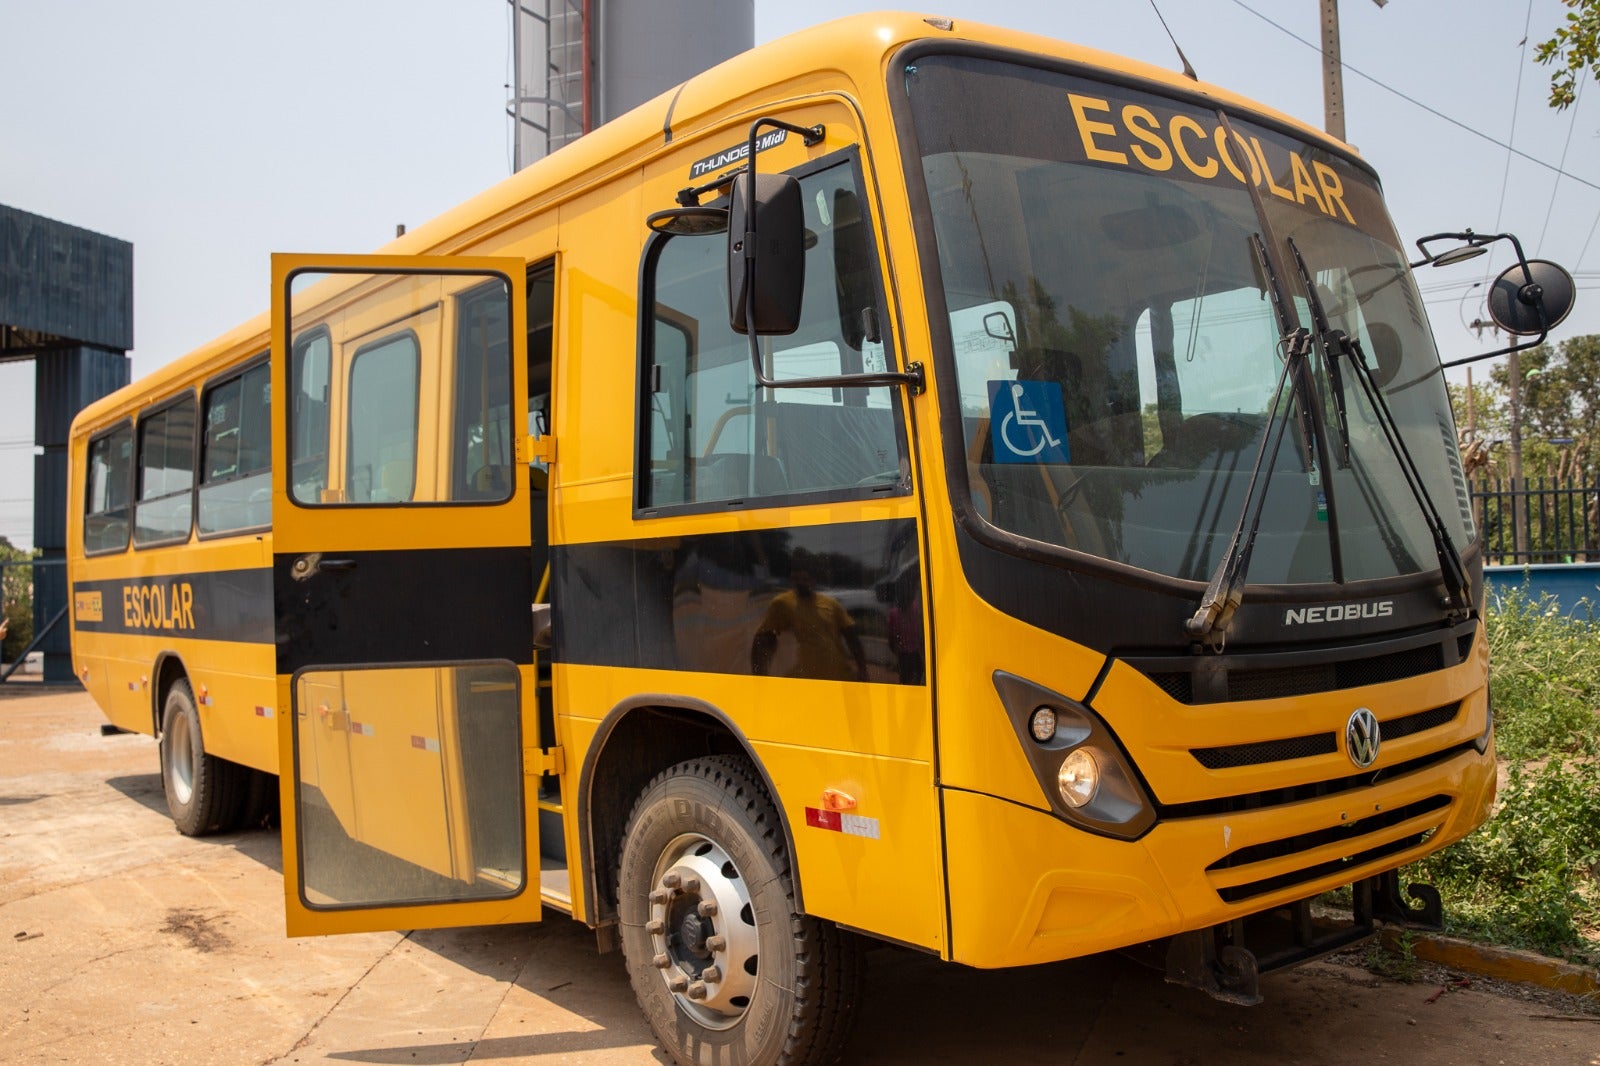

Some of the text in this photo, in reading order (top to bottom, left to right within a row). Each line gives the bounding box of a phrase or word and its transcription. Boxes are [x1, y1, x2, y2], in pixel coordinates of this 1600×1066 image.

[762, 129, 786, 149] Midi
[1067, 93, 1357, 226] ESCOLAR
[123, 583, 195, 630] ESCOLAR
[1285, 601, 1393, 626] NEOBUS
